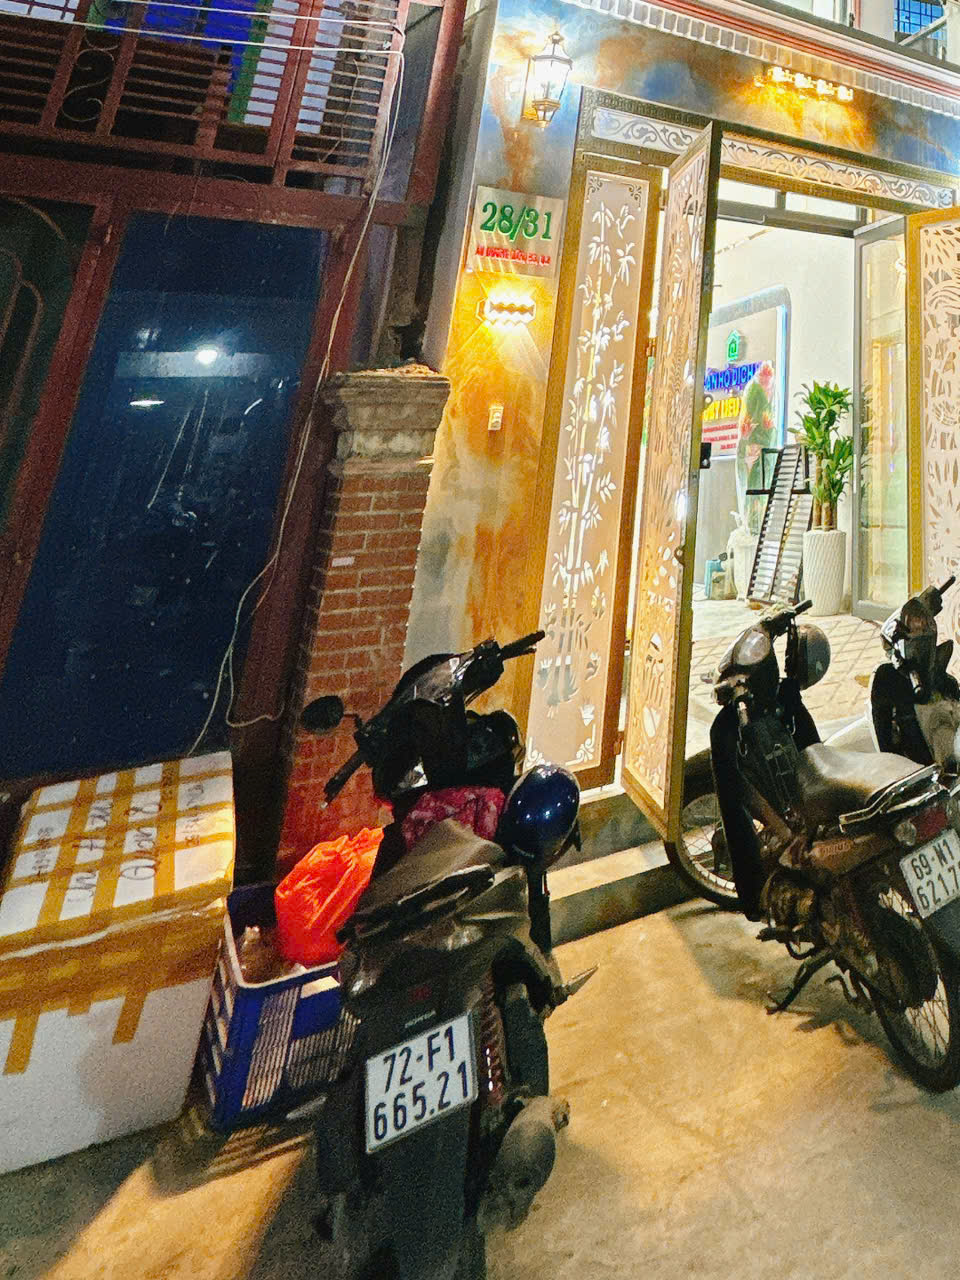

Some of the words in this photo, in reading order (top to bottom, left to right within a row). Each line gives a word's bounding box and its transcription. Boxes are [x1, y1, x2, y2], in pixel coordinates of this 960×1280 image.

[480, 202, 552, 242] 28/31
[383, 1025, 454, 1094] 72-F1
[374, 1061, 468, 1140] 665.21
